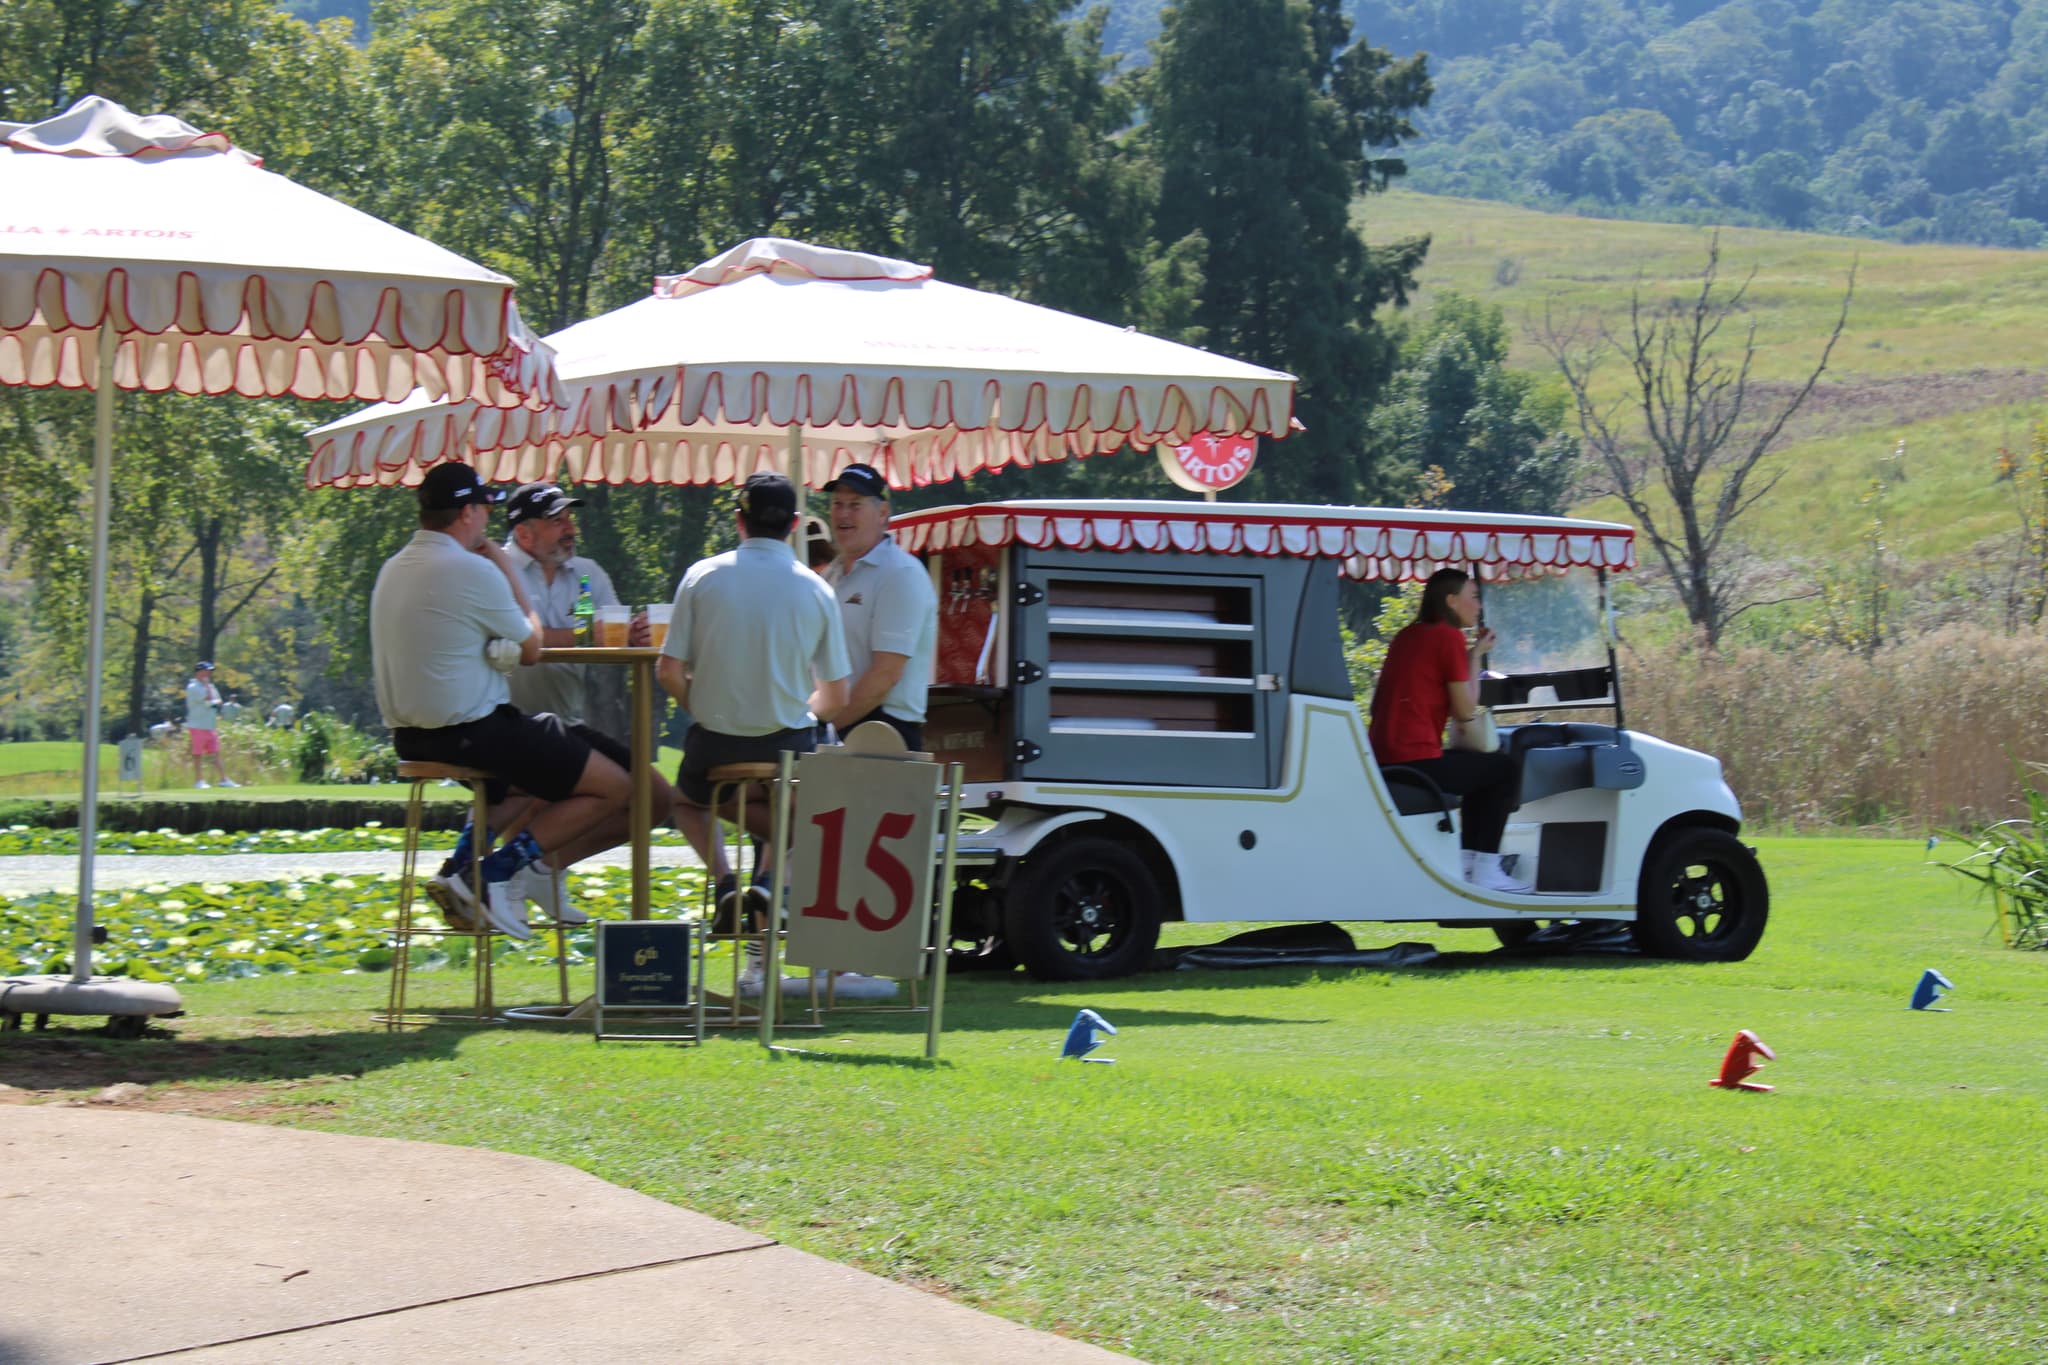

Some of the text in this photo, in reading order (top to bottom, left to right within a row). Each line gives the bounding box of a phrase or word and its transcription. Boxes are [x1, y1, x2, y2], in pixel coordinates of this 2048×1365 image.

[0, 225, 195, 239] LA ARTOIS
[1175, 446, 1252, 483] ARTOIS
[802, 806, 916, 932] 15
